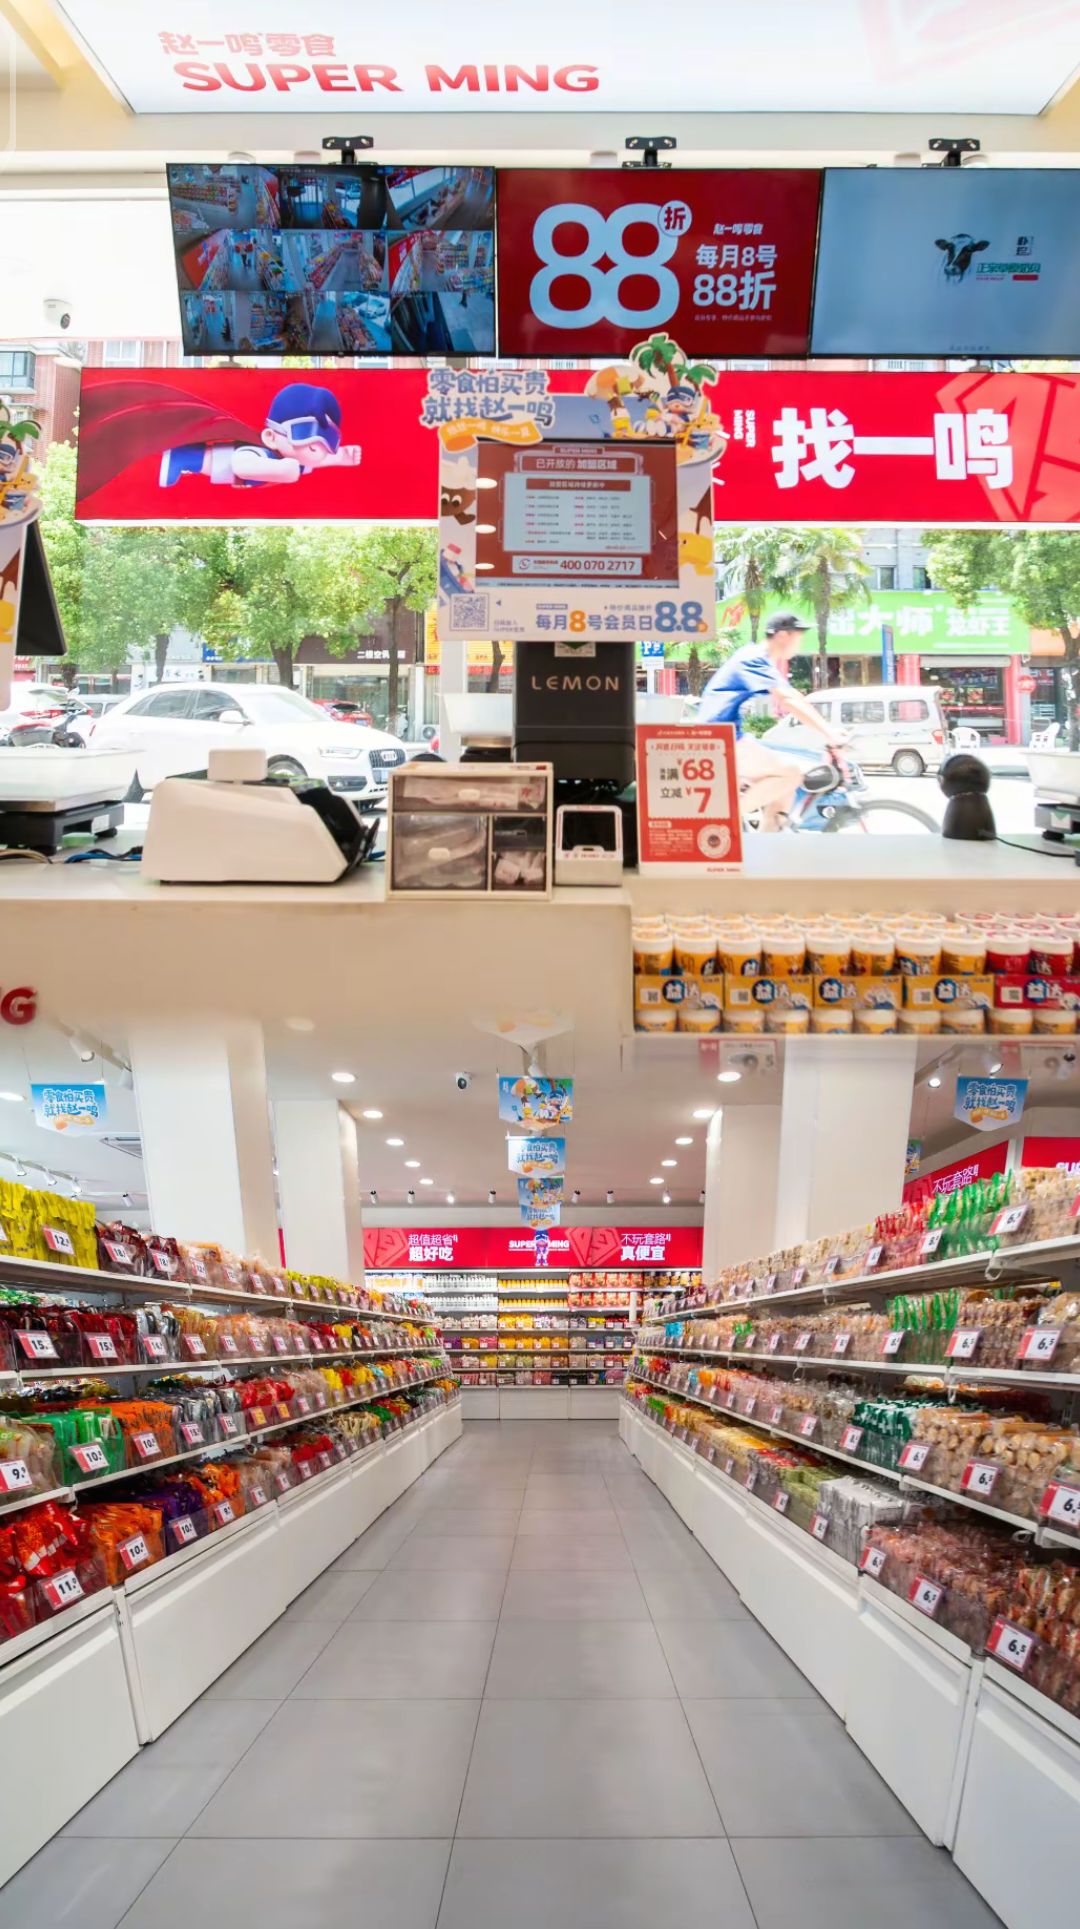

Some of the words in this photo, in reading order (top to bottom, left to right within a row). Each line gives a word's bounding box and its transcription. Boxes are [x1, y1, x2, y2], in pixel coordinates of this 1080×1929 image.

[158, 31, 336, 57] 赵一鸣零食
[173, 62, 404, 92] SUPER
[424, 64, 599, 92] MING
[664, 207, 686, 230] 折
[529, 203, 680, 329] 88
[696, 244, 777, 269] 每月8号
[692, 271, 777, 310] 88折
[429, 368, 548, 395] 零食怕买贵
[423, 396, 554, 426] 就找赵一鸣
[733, 409, 744, 440] MING
[745, 409, 756, 448] SUPER
[771, 407, 1014, 490] 找一鸣
[560, 559, 582, 570] 400
[583, 559, 605, 571] 070
[607, 560, 635, 571] 2717
[536, 610, 652, 633] 每月8号会员日
[655, 600, 703, 633] 8.8
[531, 675, 619, 691] LEMON
[666, 983, 699, 999] 益达
[756, 982, 790, 999] 益达
[823, 981, 857, 999] 益达
[937, 982, 971, 999] 益达
[1027, 982, 1063, 999] 益达
[0, 986, 37, 1025] G
[508, 1239, 536, 1249] SUPER
[548, 1239, 570, 1249] MING
[621, 1233, 666, 1245] 不玩套路
[409, 1246, 454, 1262] 超好吃
[620, 1245, 666, 1261] 真便宜
[1037, 1337, 1055, 1351] 6.5
[978, 1473, 993, 1486] 6.5
[1007, 1639, 1028, 1657] 6.5
